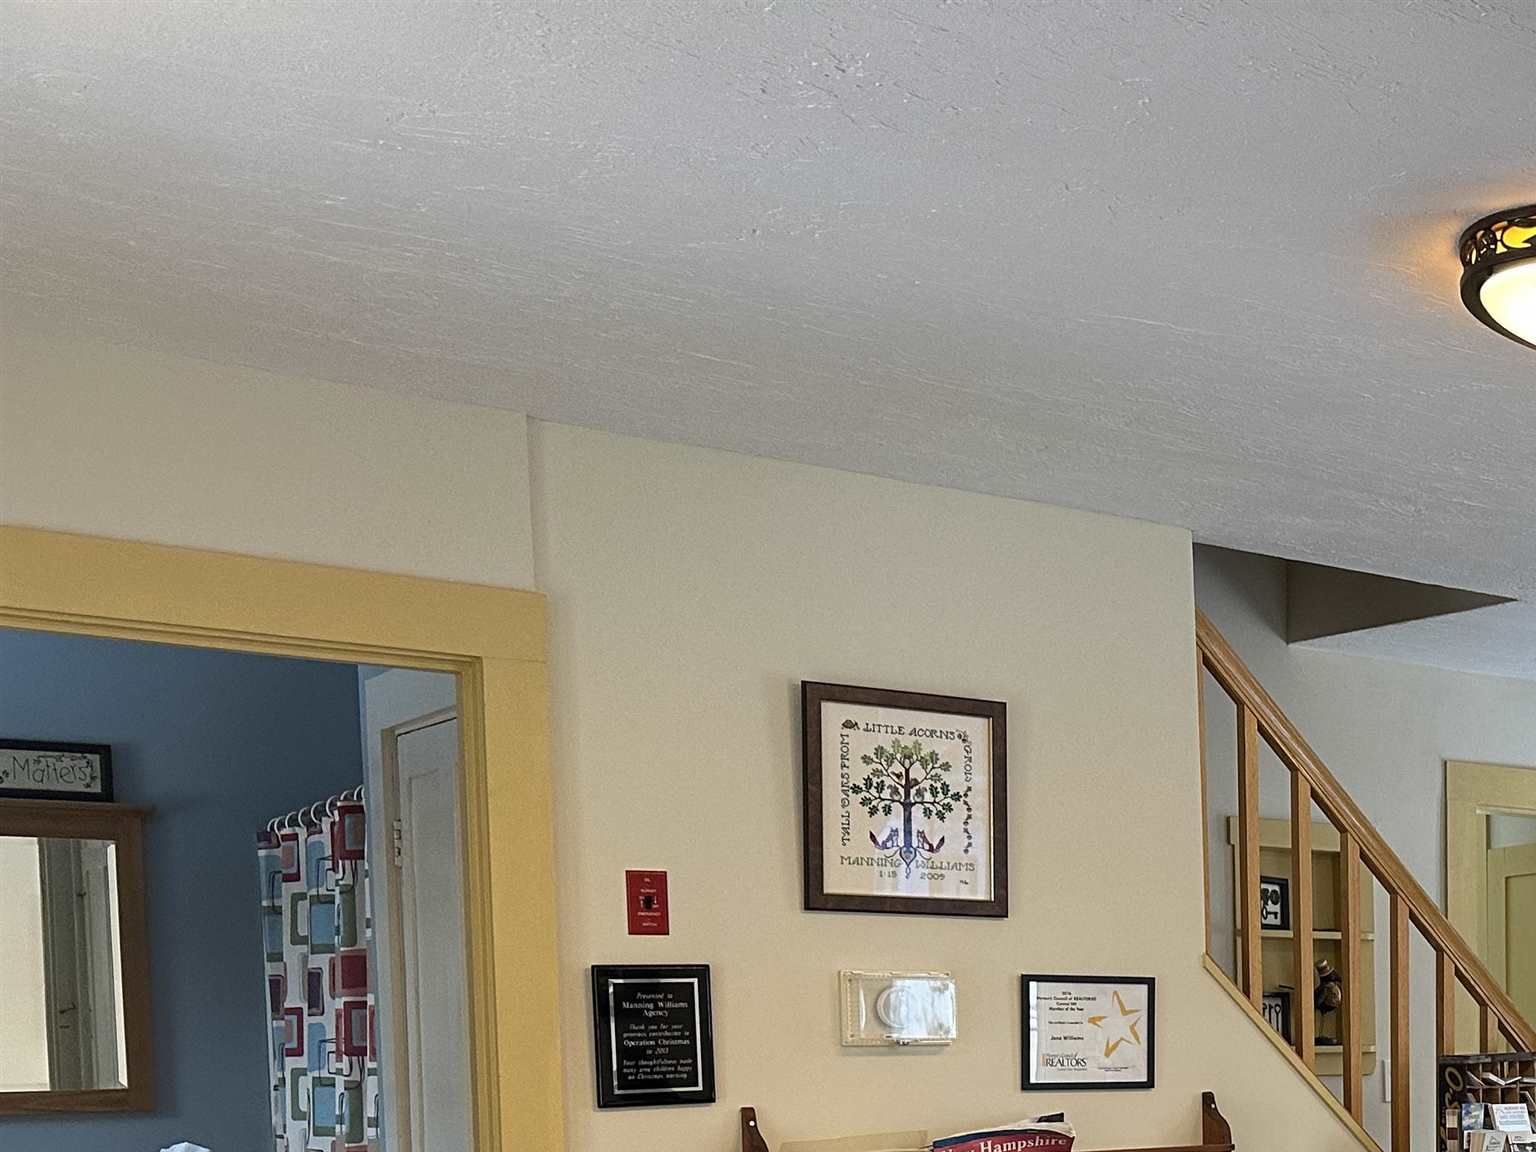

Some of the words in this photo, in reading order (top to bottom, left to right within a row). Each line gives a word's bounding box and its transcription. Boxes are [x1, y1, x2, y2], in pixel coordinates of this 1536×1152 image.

[863, 722, 905, 736] LITTLE
[909, 727, 955, 740] ACORNS
[840, 733, 850, 770] FROM
[12, 756, 88, 784] Matters
[841, 810, 850, 847] TALL
[840, 855, 902, 868] MANNING
[915, 860, 976, 872] WILLIAMS
[622, 1001, 654, 1009] Manning
[1045, 1057, 1087, 1068] REALTORS
